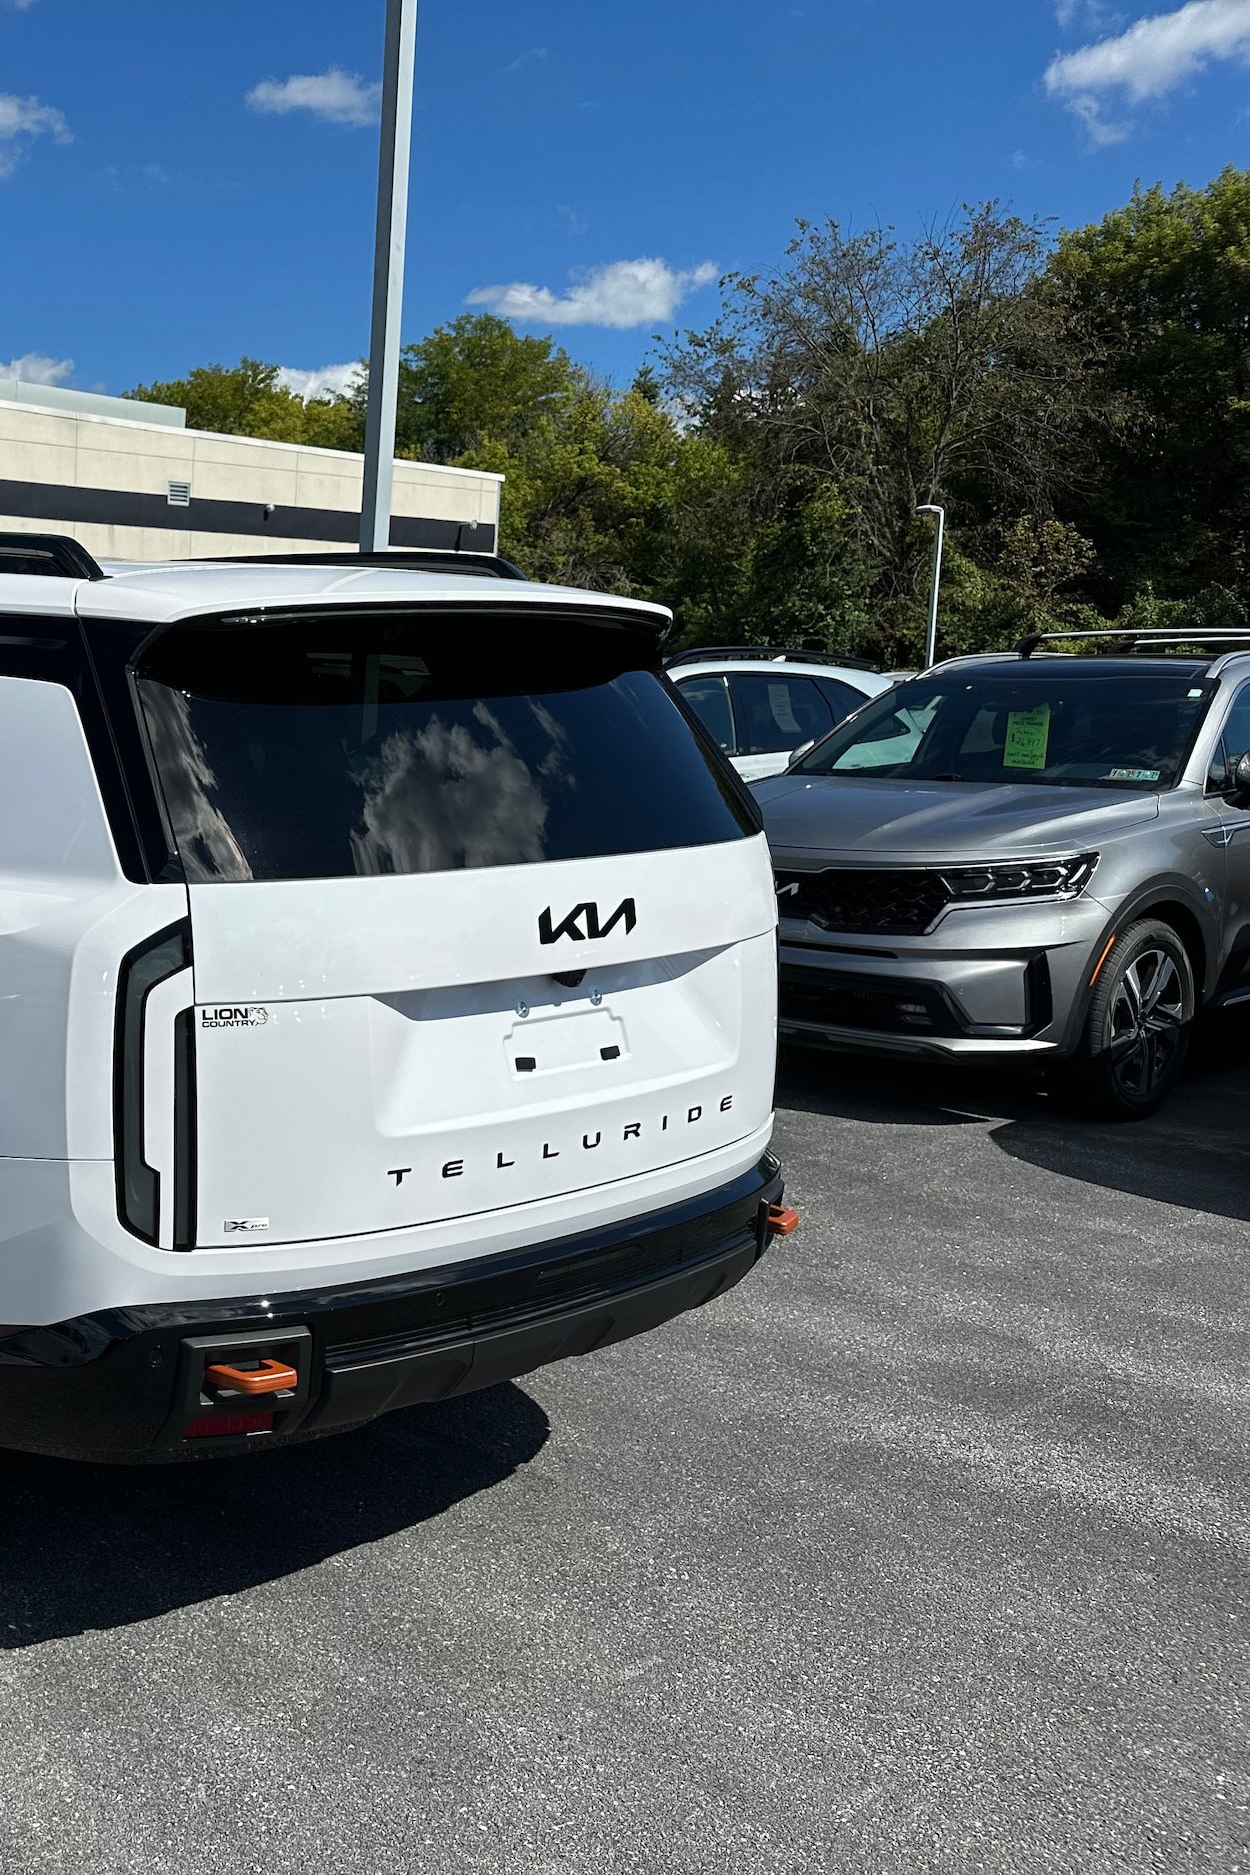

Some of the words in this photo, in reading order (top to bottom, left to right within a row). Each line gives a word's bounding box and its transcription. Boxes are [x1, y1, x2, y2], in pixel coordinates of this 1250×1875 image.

[538, 897, 637, 945] KIA
[201, 1007, 249, 1021] LION
[201, 1019, 256, 1028] COUNTRY
[387, 1095, 734, 1187] TELLURIDE
